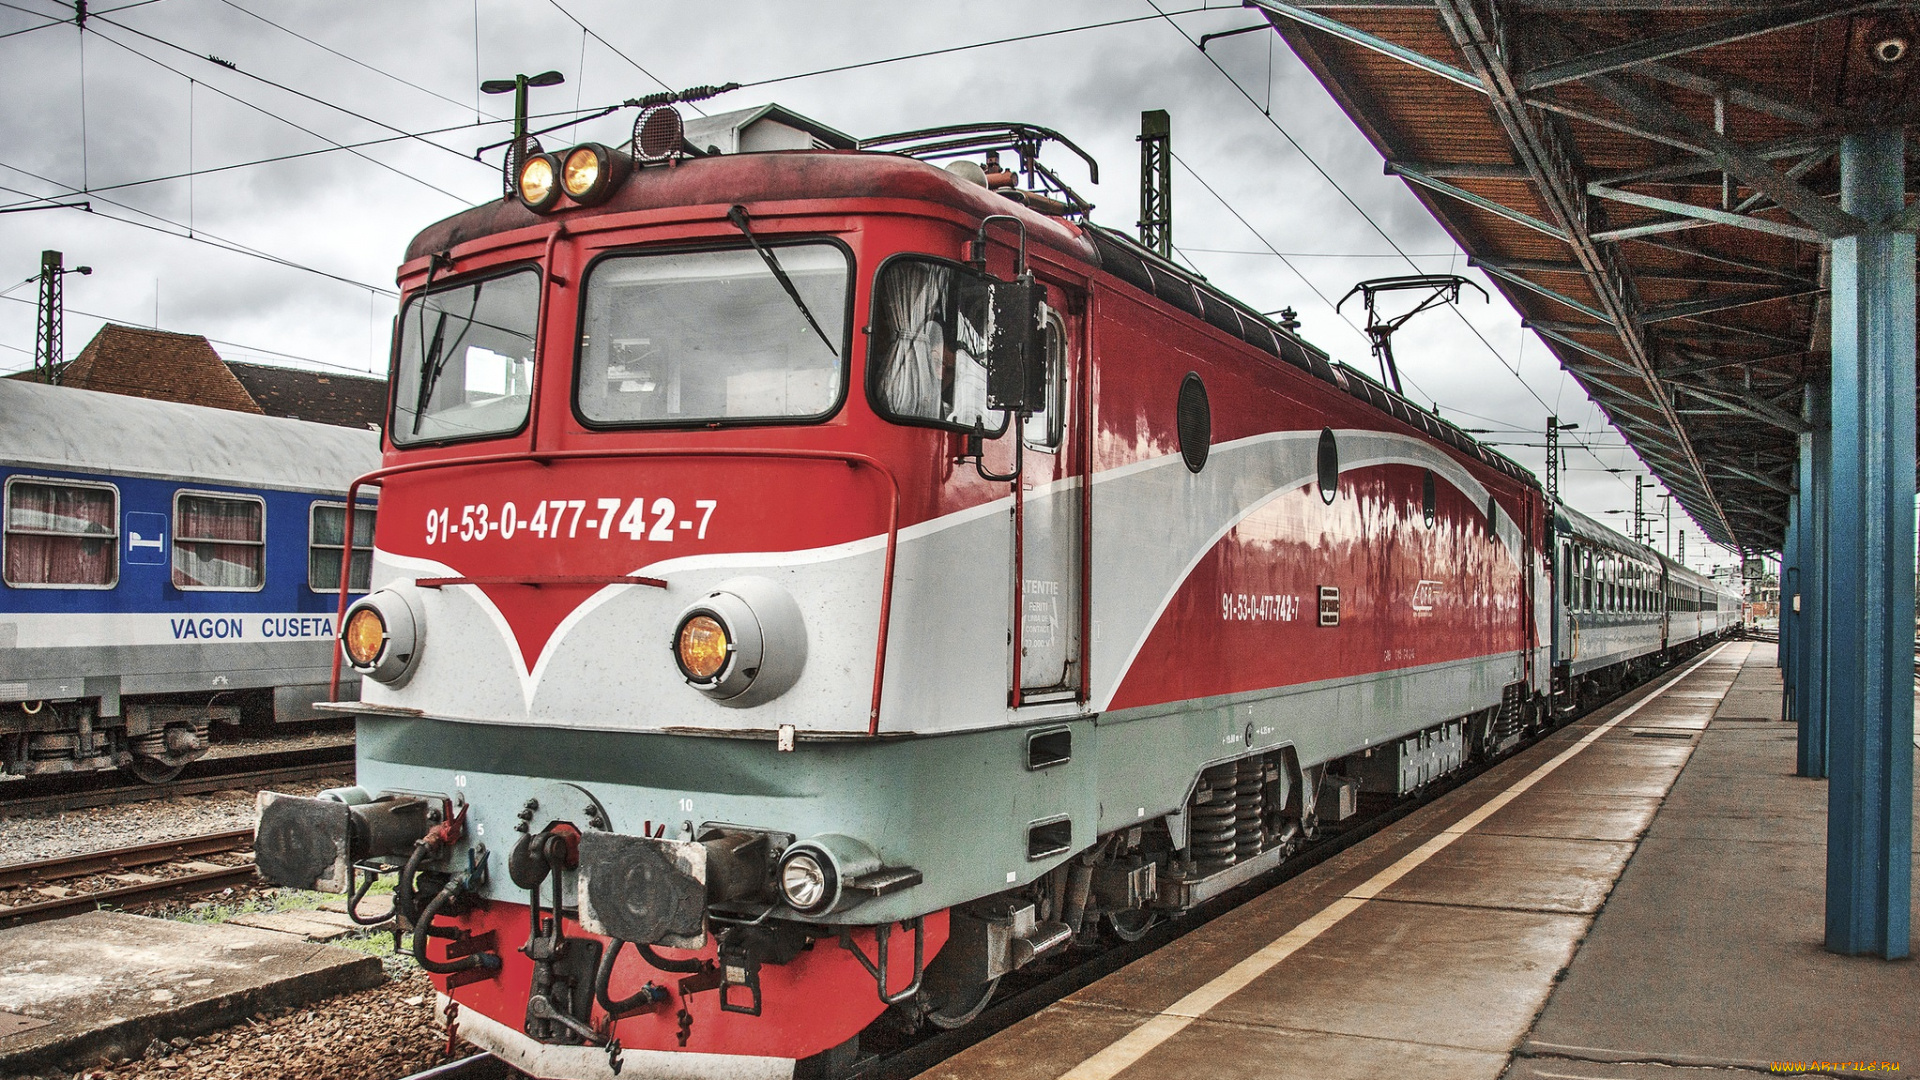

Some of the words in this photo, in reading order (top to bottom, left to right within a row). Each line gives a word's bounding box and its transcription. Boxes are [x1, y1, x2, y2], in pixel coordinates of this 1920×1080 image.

[425, 497, 717, 545] 91-53-0-477-742-7
[1222, 593, 1300, 622] 91-53-0-477-742-7
[171, 618, 243, 639] VAGON
[262, 617, 334, 637] CUSETA
[454, 775, 467, 788] 10
[679, 798, 693, 812] 10
[477, 824, 485, 836] 5
